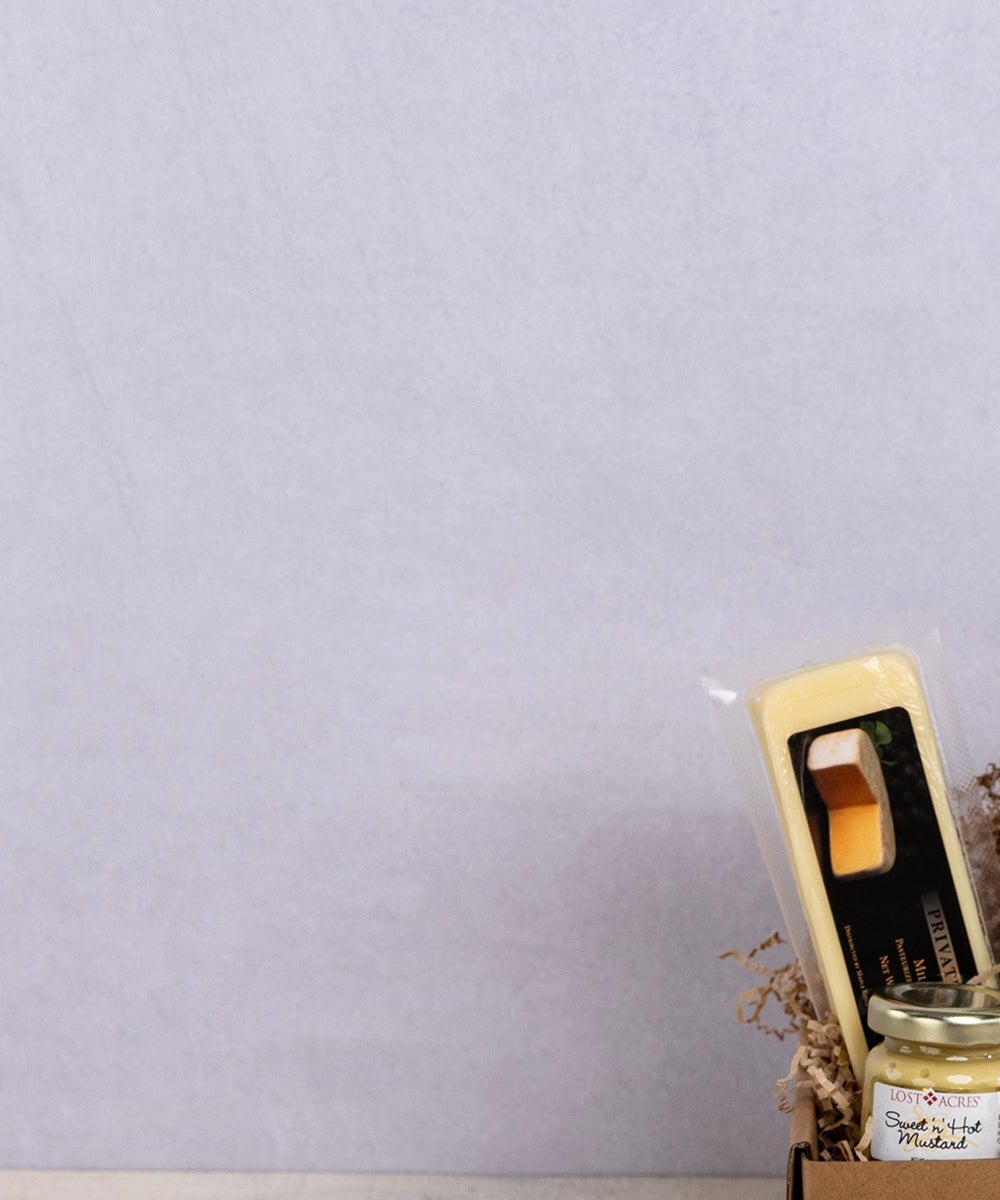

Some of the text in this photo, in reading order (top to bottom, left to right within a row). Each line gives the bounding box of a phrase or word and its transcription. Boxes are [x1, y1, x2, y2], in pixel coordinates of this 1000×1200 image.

[928, 908, 962, 984] PRIVAT
[890, 1088, 981, 1108] LOST ACRES
[885, 1111, 929, 1132] Sweet
[947, 1117, 982, 1135] Hot
[898, 1129, 968, 1150] Mustard
